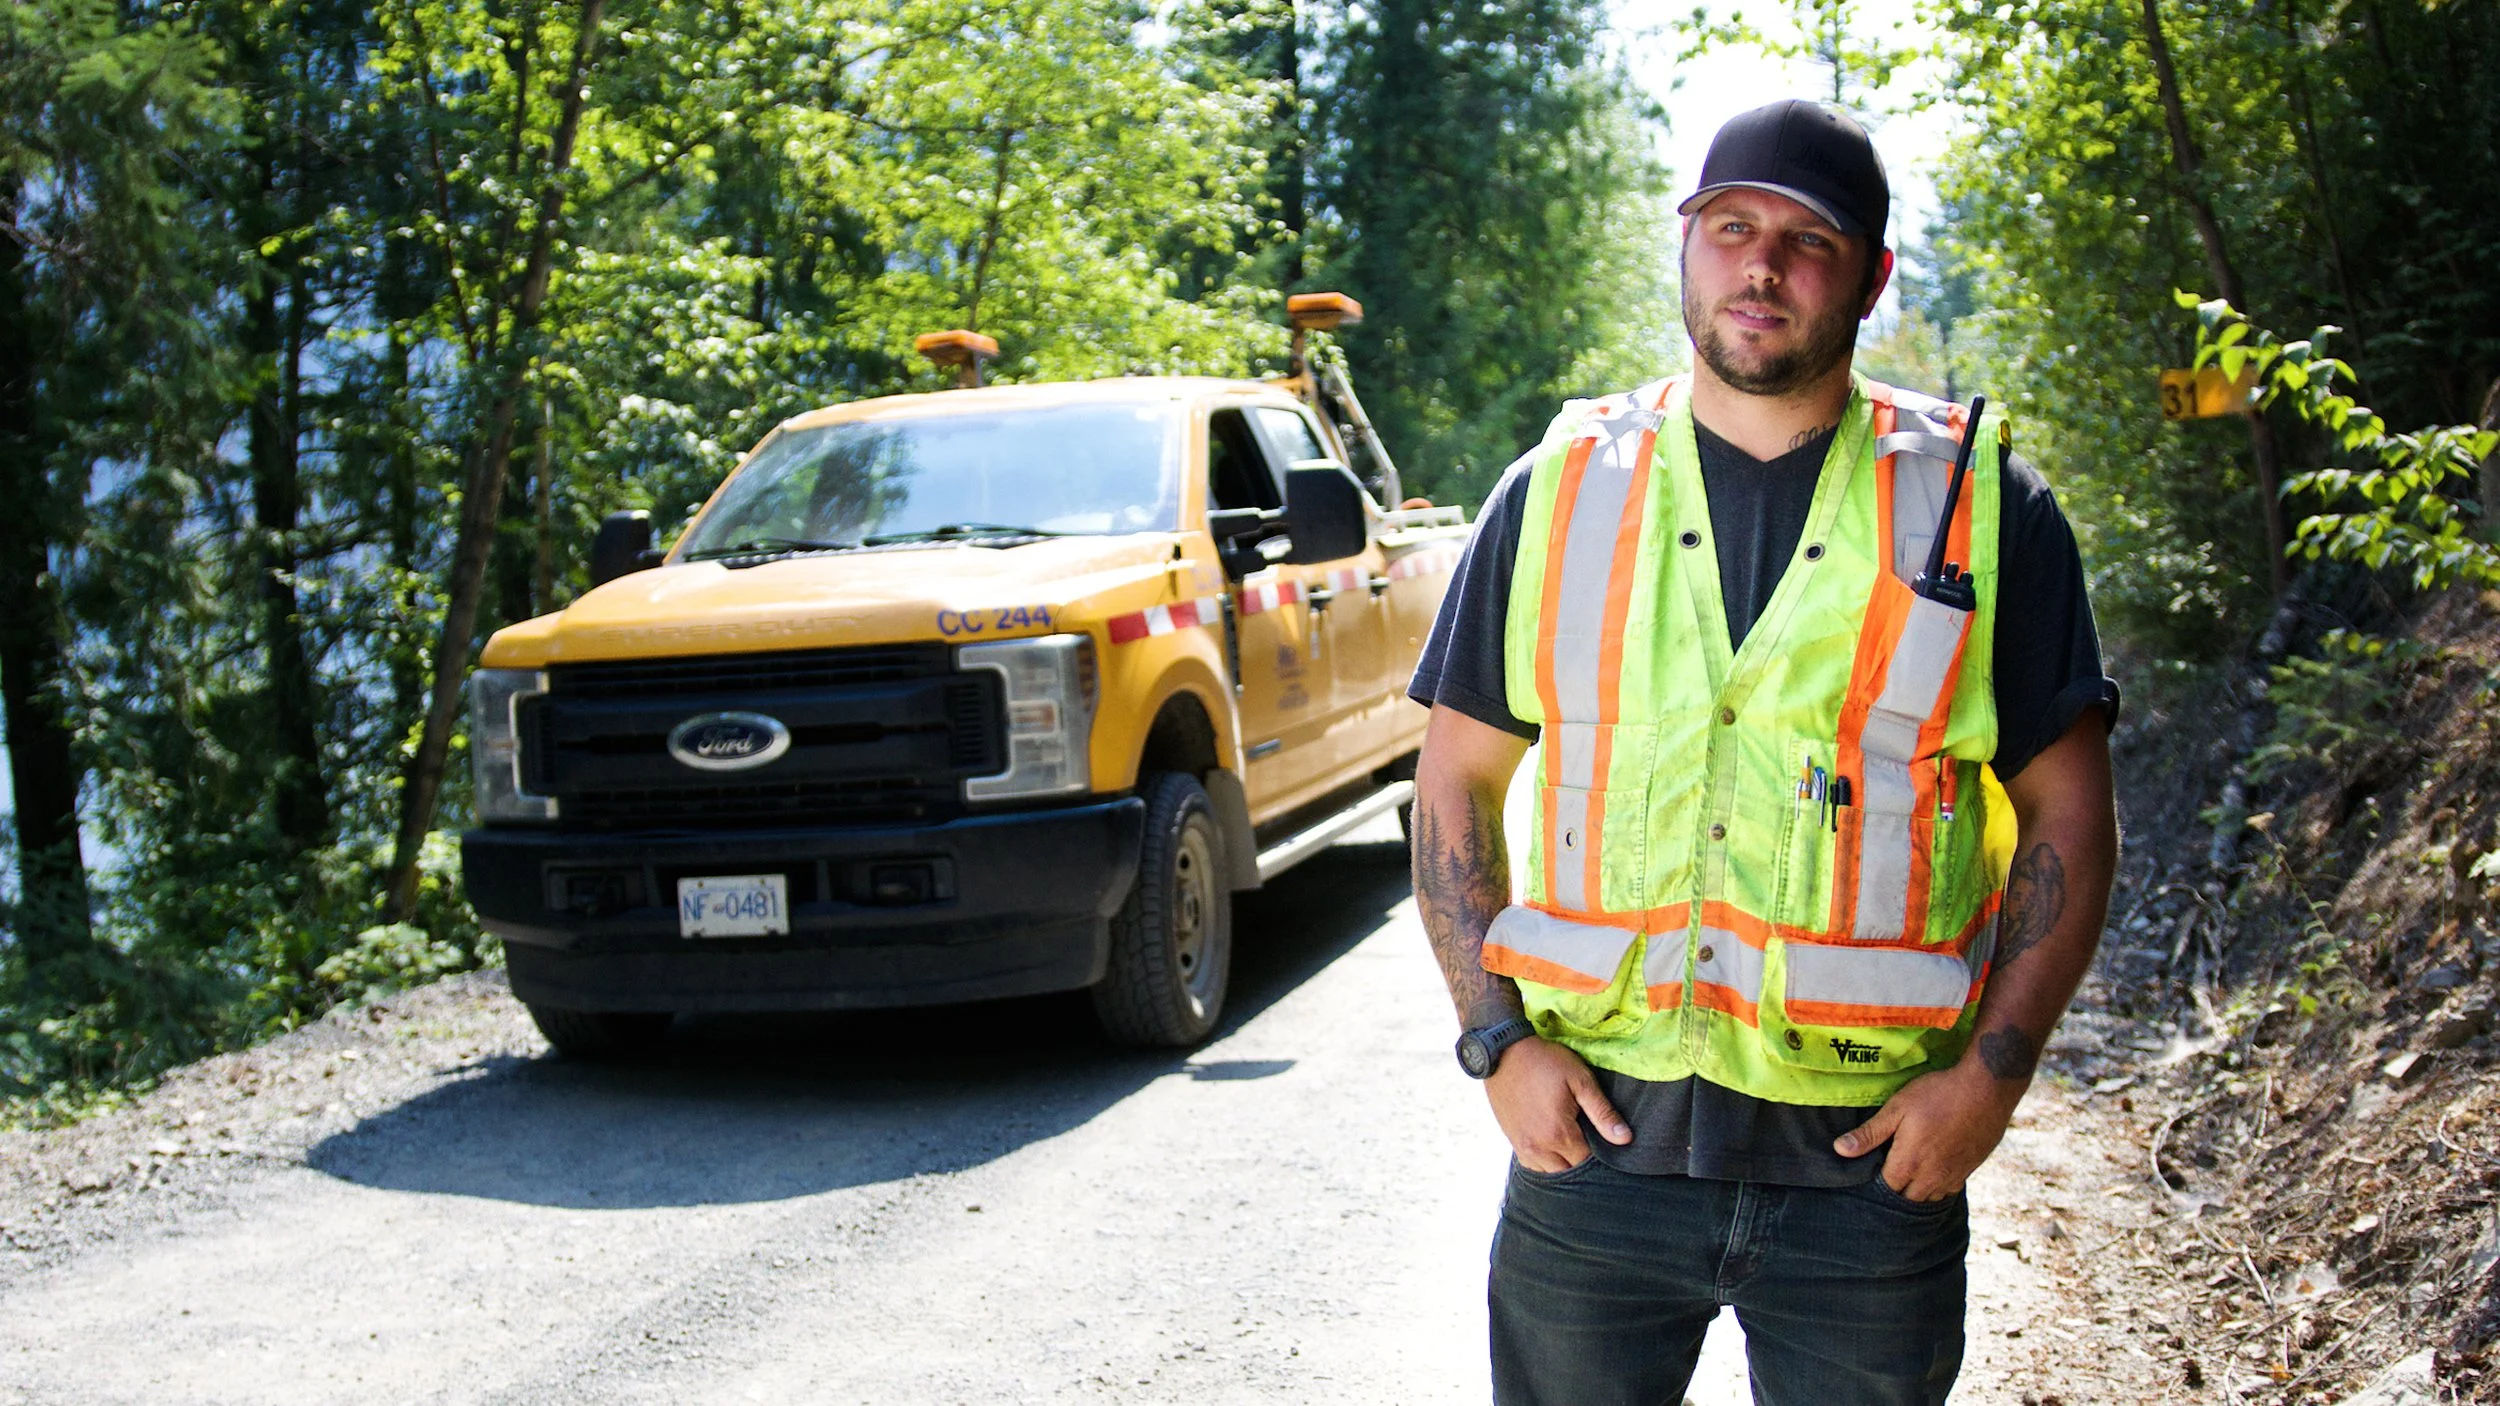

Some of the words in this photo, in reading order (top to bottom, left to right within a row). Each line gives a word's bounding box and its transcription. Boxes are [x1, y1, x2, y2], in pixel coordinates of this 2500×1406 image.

[2164, 380, 2199, 417] 31
[937, 609, 984, 635] CC
[993, 604, 1051, 630] 244
[697, 726, 754, 755] Ford
[1832, 1044, 1880, 1065] VIKING
